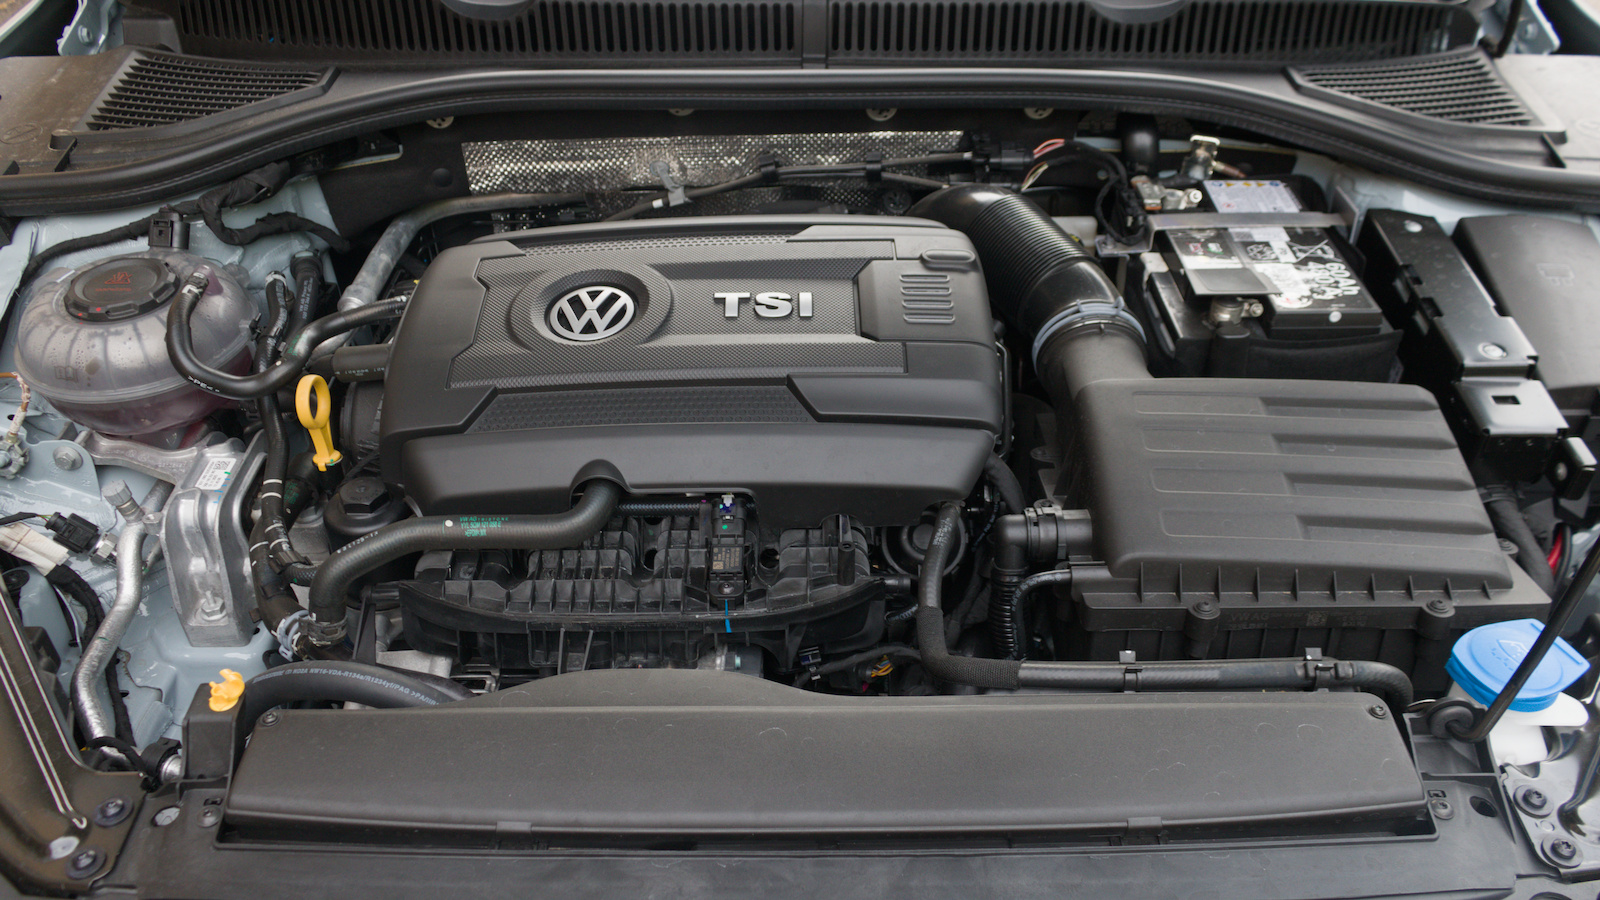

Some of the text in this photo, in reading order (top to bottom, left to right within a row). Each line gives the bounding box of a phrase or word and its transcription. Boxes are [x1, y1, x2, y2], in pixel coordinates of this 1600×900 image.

[1325, 262, 1360, 295] 60Ah
[550, 285, 634, 341] VW
[714, 292, 813, 317] TSI
